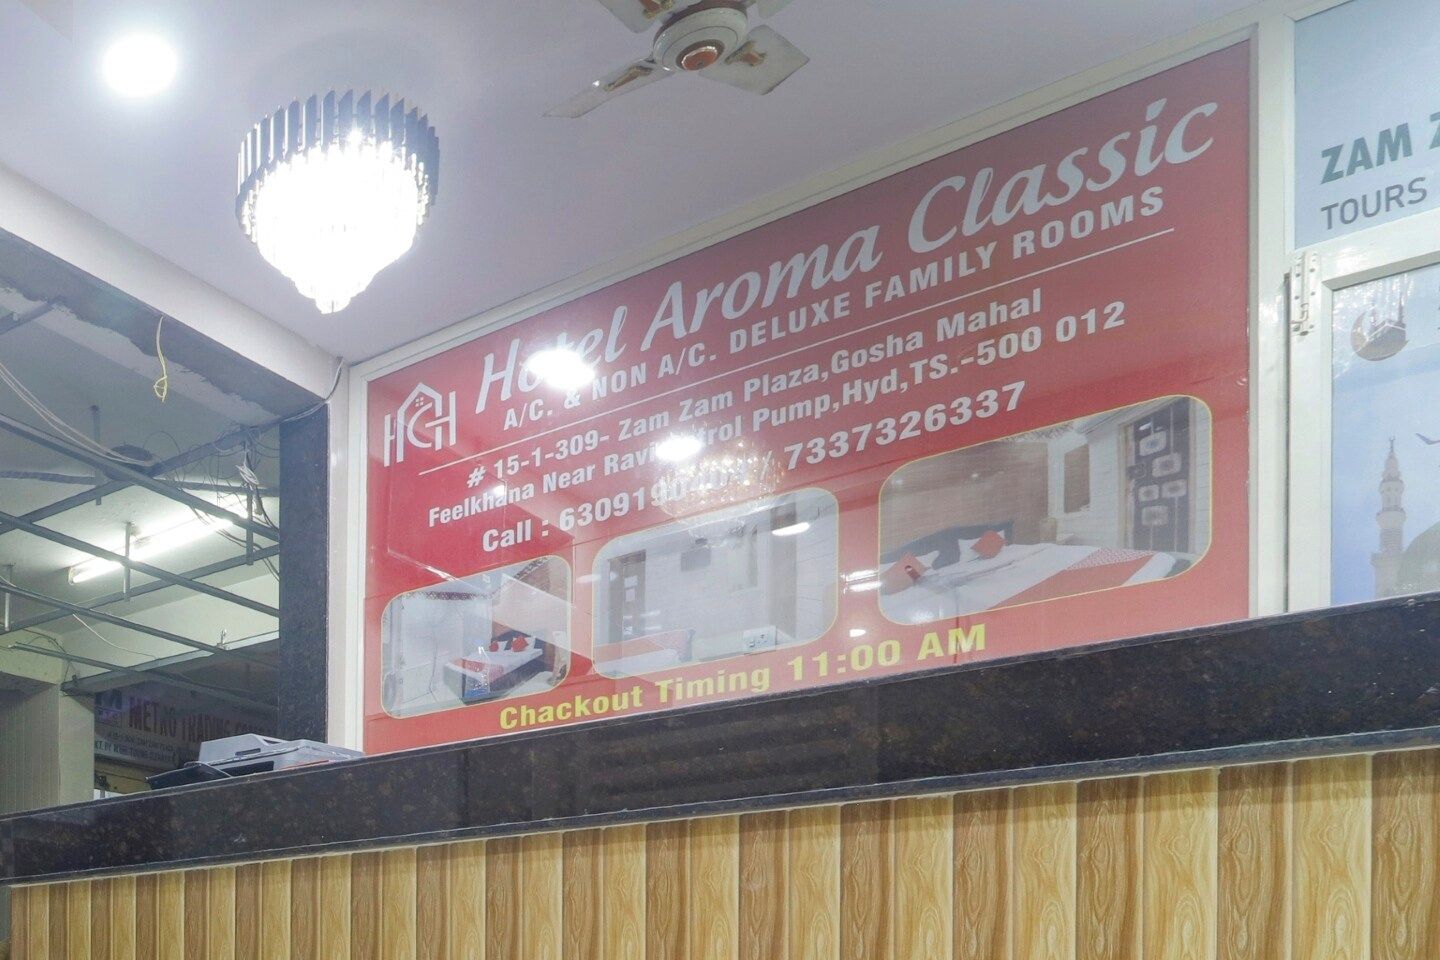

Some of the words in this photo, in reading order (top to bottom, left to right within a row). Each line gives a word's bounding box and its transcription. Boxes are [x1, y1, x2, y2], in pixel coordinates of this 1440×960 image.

[640, 223, 883, 353] Aroma
[907, 98, 1218, 254] Classic
[1321, 122, 1413, 184] ZAM
[1321, 177, 1427, 230] TOURS
[467, 467, 486, 488] #
[618, 413, 670, 443] Zam
[679, 389, 734, 421] Zam
[937, 288, 1042, 344] Mahal
[503, 398, 553, 431] A/C.
[592, 362, 647, 401] NON
[657, 342, 717, 379] A/C.
[729, 292, 851, 355] DELUXE
[864, 240, 998, 309] FAMILY
[1012, 186, 1165, 259] ROOMS
[428, 481, 535, 528] Feelkhana
[543, 466, 593, 494] Near
[1055, 300, 1126, 344] 012
[482, 519, 532, 554] Call
[784, 381, 1027, 471] 7337326337
[499, 686, 644, 731] Chackout
[655, 663, 771, 706] Timing
[788, 639, 902, 682] 11:00
[917, 623, 987, 662] AM
